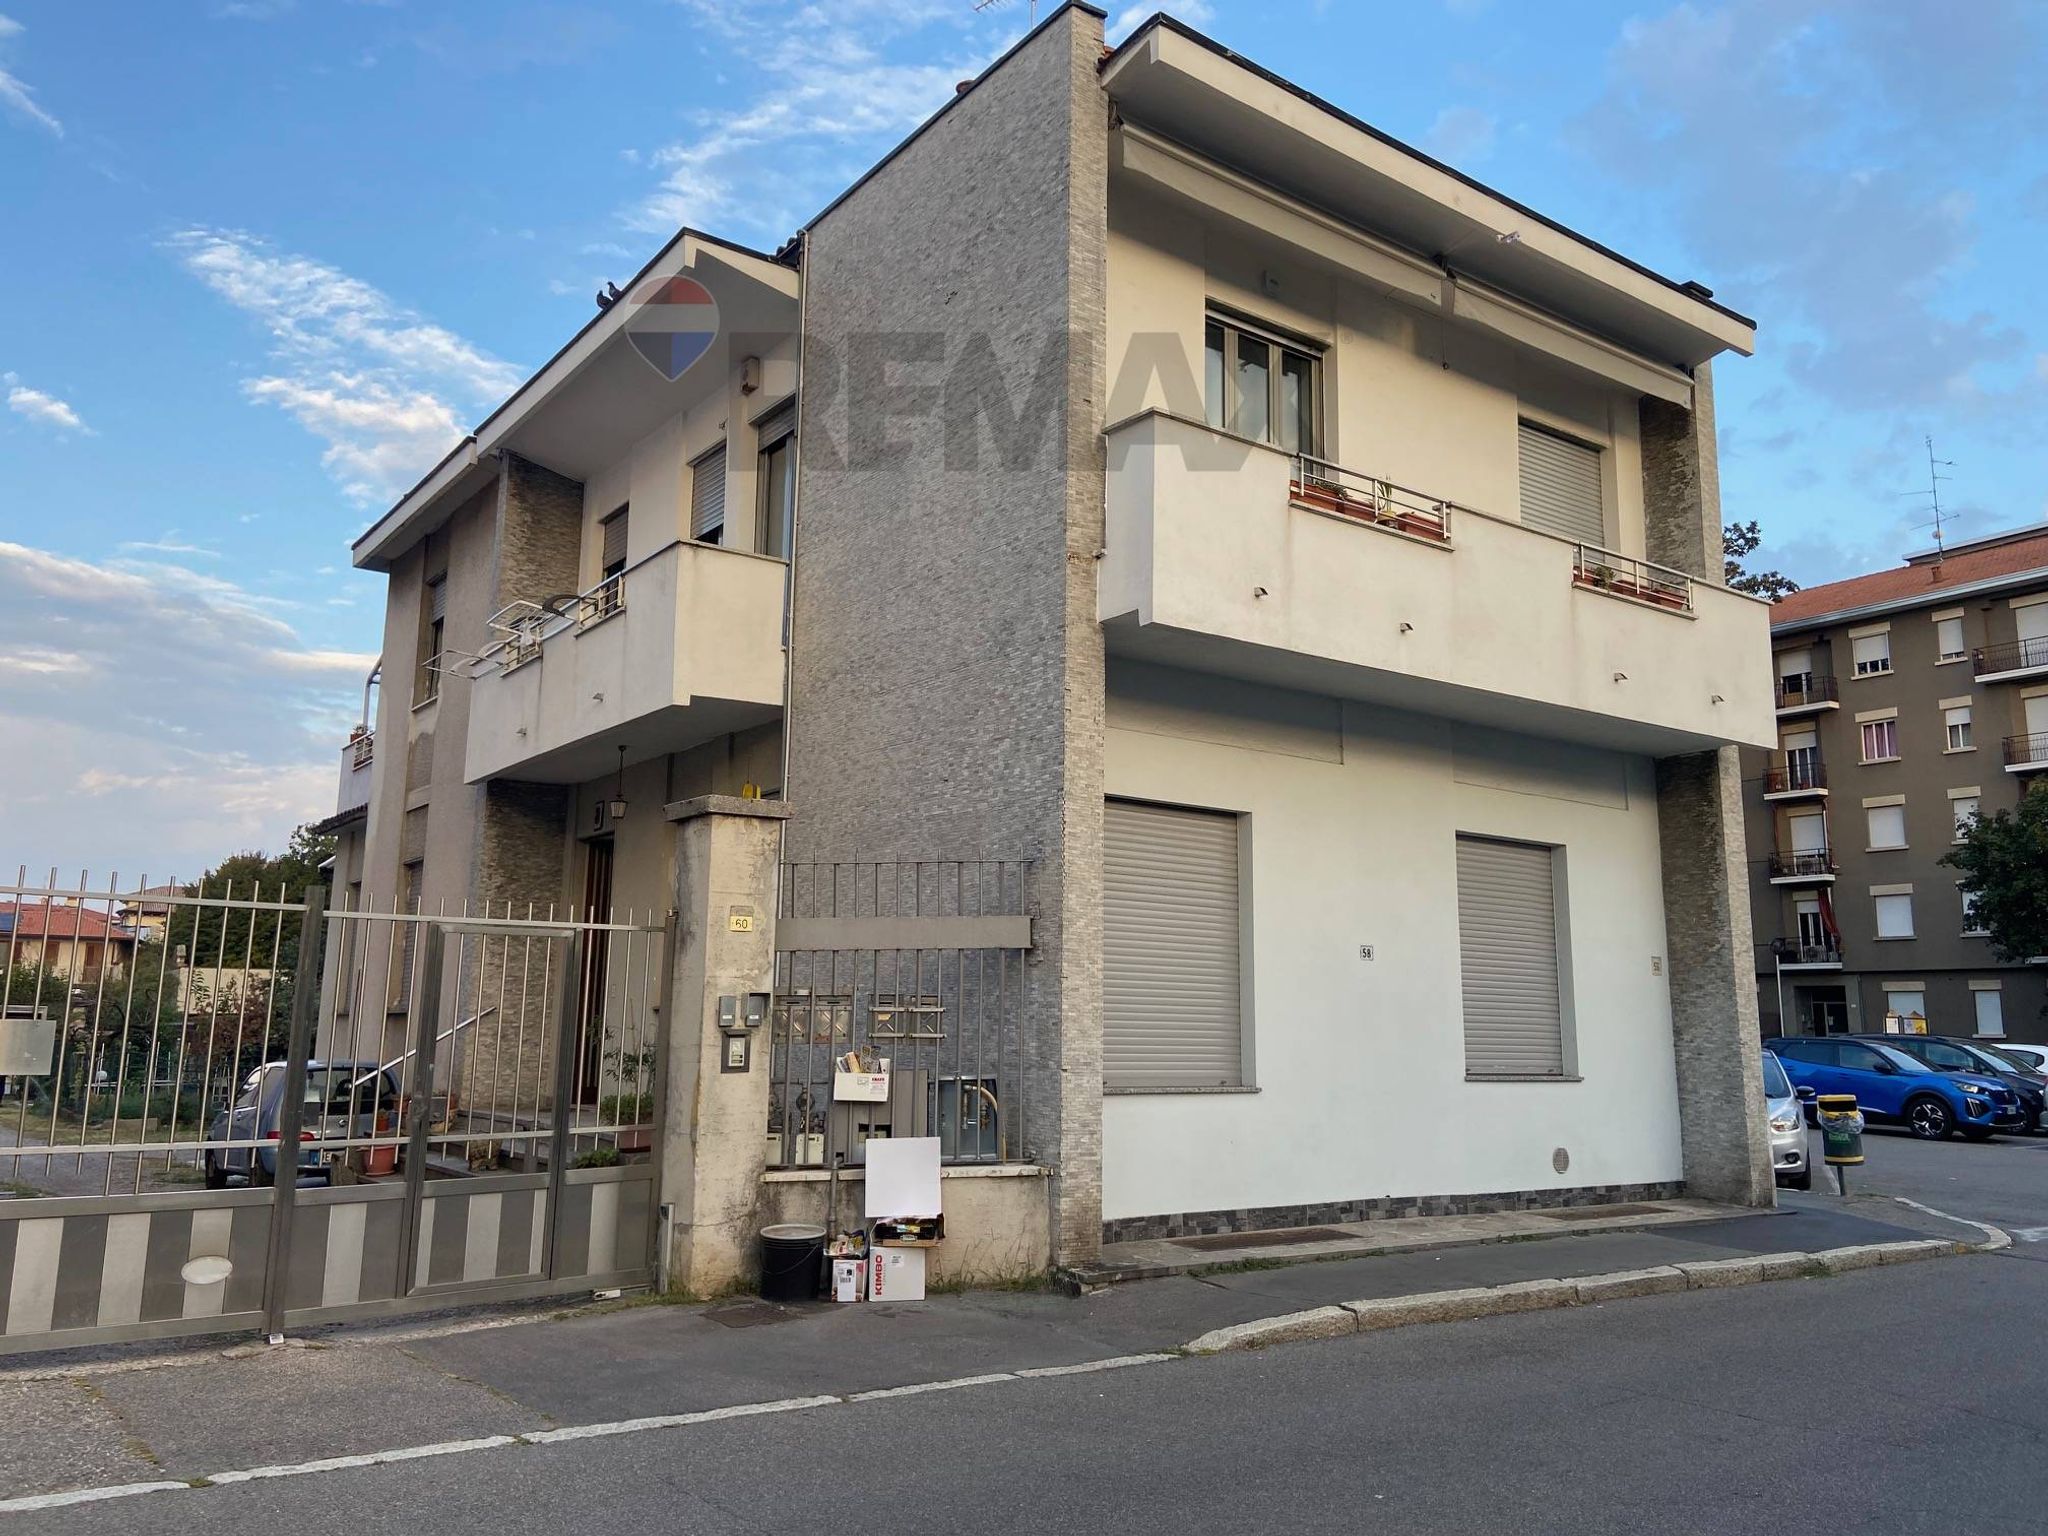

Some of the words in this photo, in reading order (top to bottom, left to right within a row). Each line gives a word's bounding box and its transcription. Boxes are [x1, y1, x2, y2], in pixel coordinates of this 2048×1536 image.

[735, 918, 748, 929] 60
[1362, 947, 1371, 958] 58
[874, 1254, 883, 1296] KIMBO
